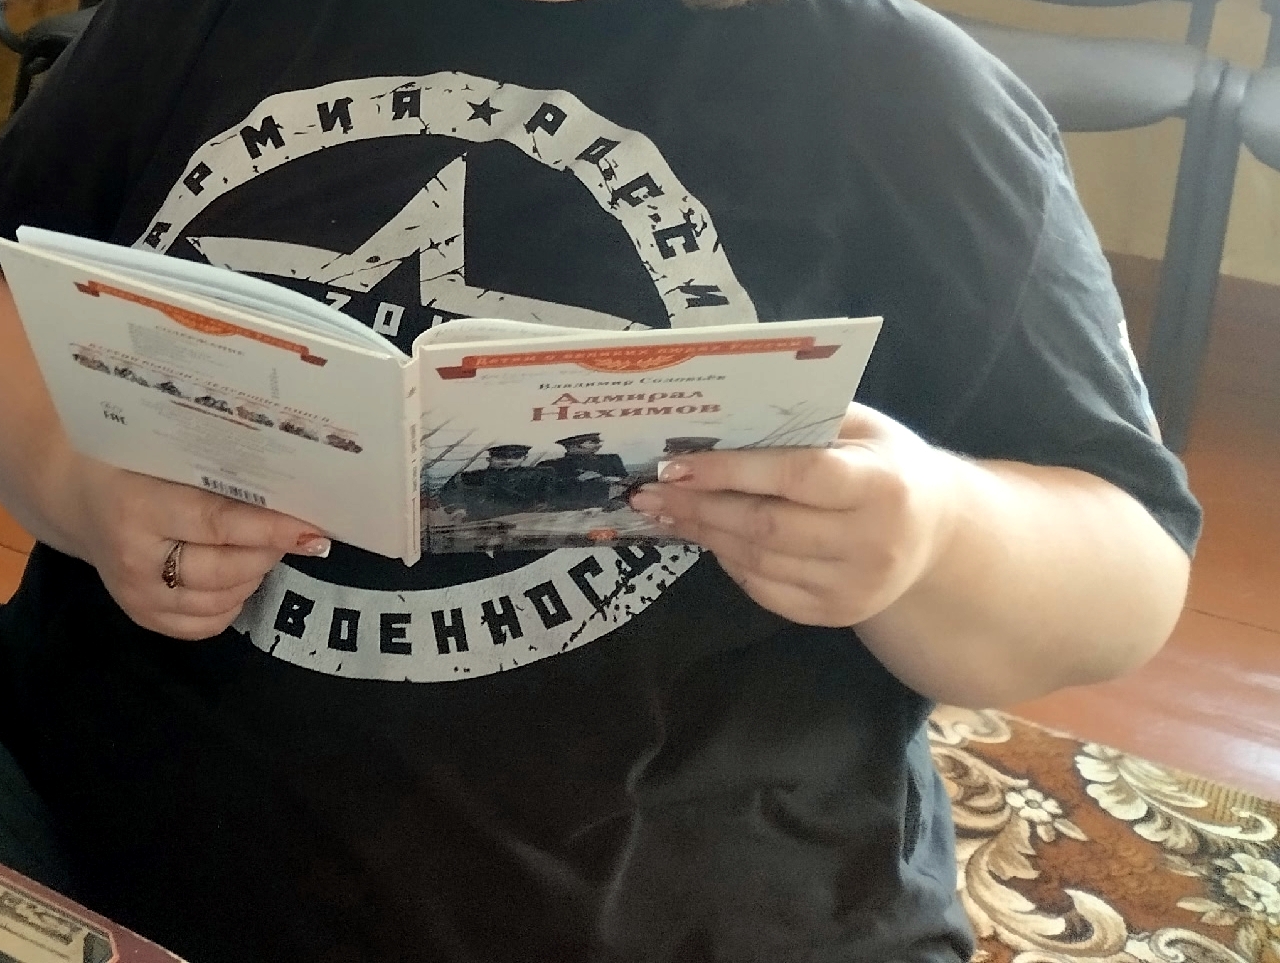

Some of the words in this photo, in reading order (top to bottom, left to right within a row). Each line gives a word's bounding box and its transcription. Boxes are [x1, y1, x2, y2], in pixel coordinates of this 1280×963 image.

[142, 86, 422, 249] АРМИЯ
[522, 100, 731, 309] РОССИ
[538, 378, 635, 391] Владимир
[551, 390, 705, 406] Адмирал
[530, 404, 722, 423] Нахимов
